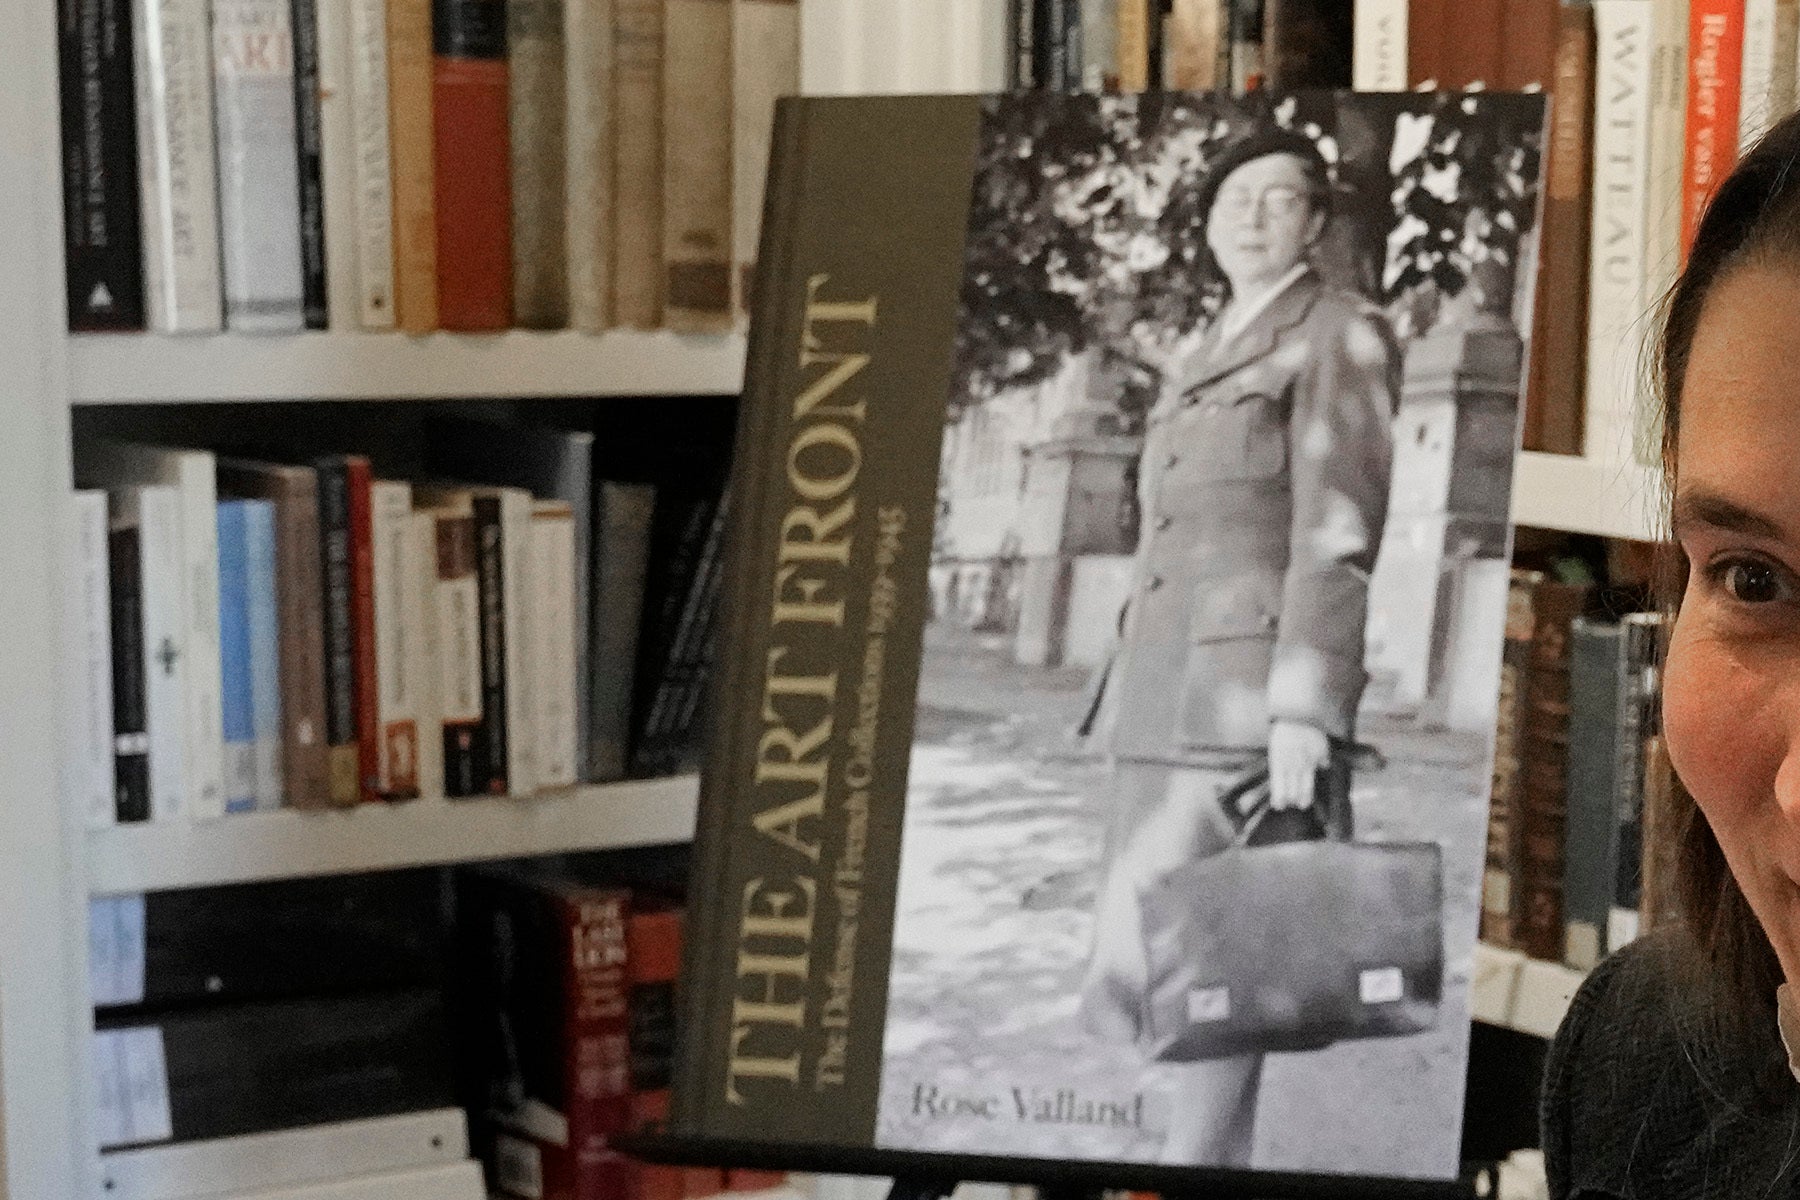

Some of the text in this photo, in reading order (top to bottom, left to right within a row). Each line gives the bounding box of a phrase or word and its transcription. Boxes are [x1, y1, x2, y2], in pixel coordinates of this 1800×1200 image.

[1604, 24, 1643, 286] WATTEAU
[726, 272, 880, 1106] THE ART FRONT
[843, 634, 890, 788] Collections
[834, 788, 875, 887] French
[831, 887, 863, 919] of
[812, 1031, 850, 1088] The
[909, 1076, 1147, 1137] Rose Valland
